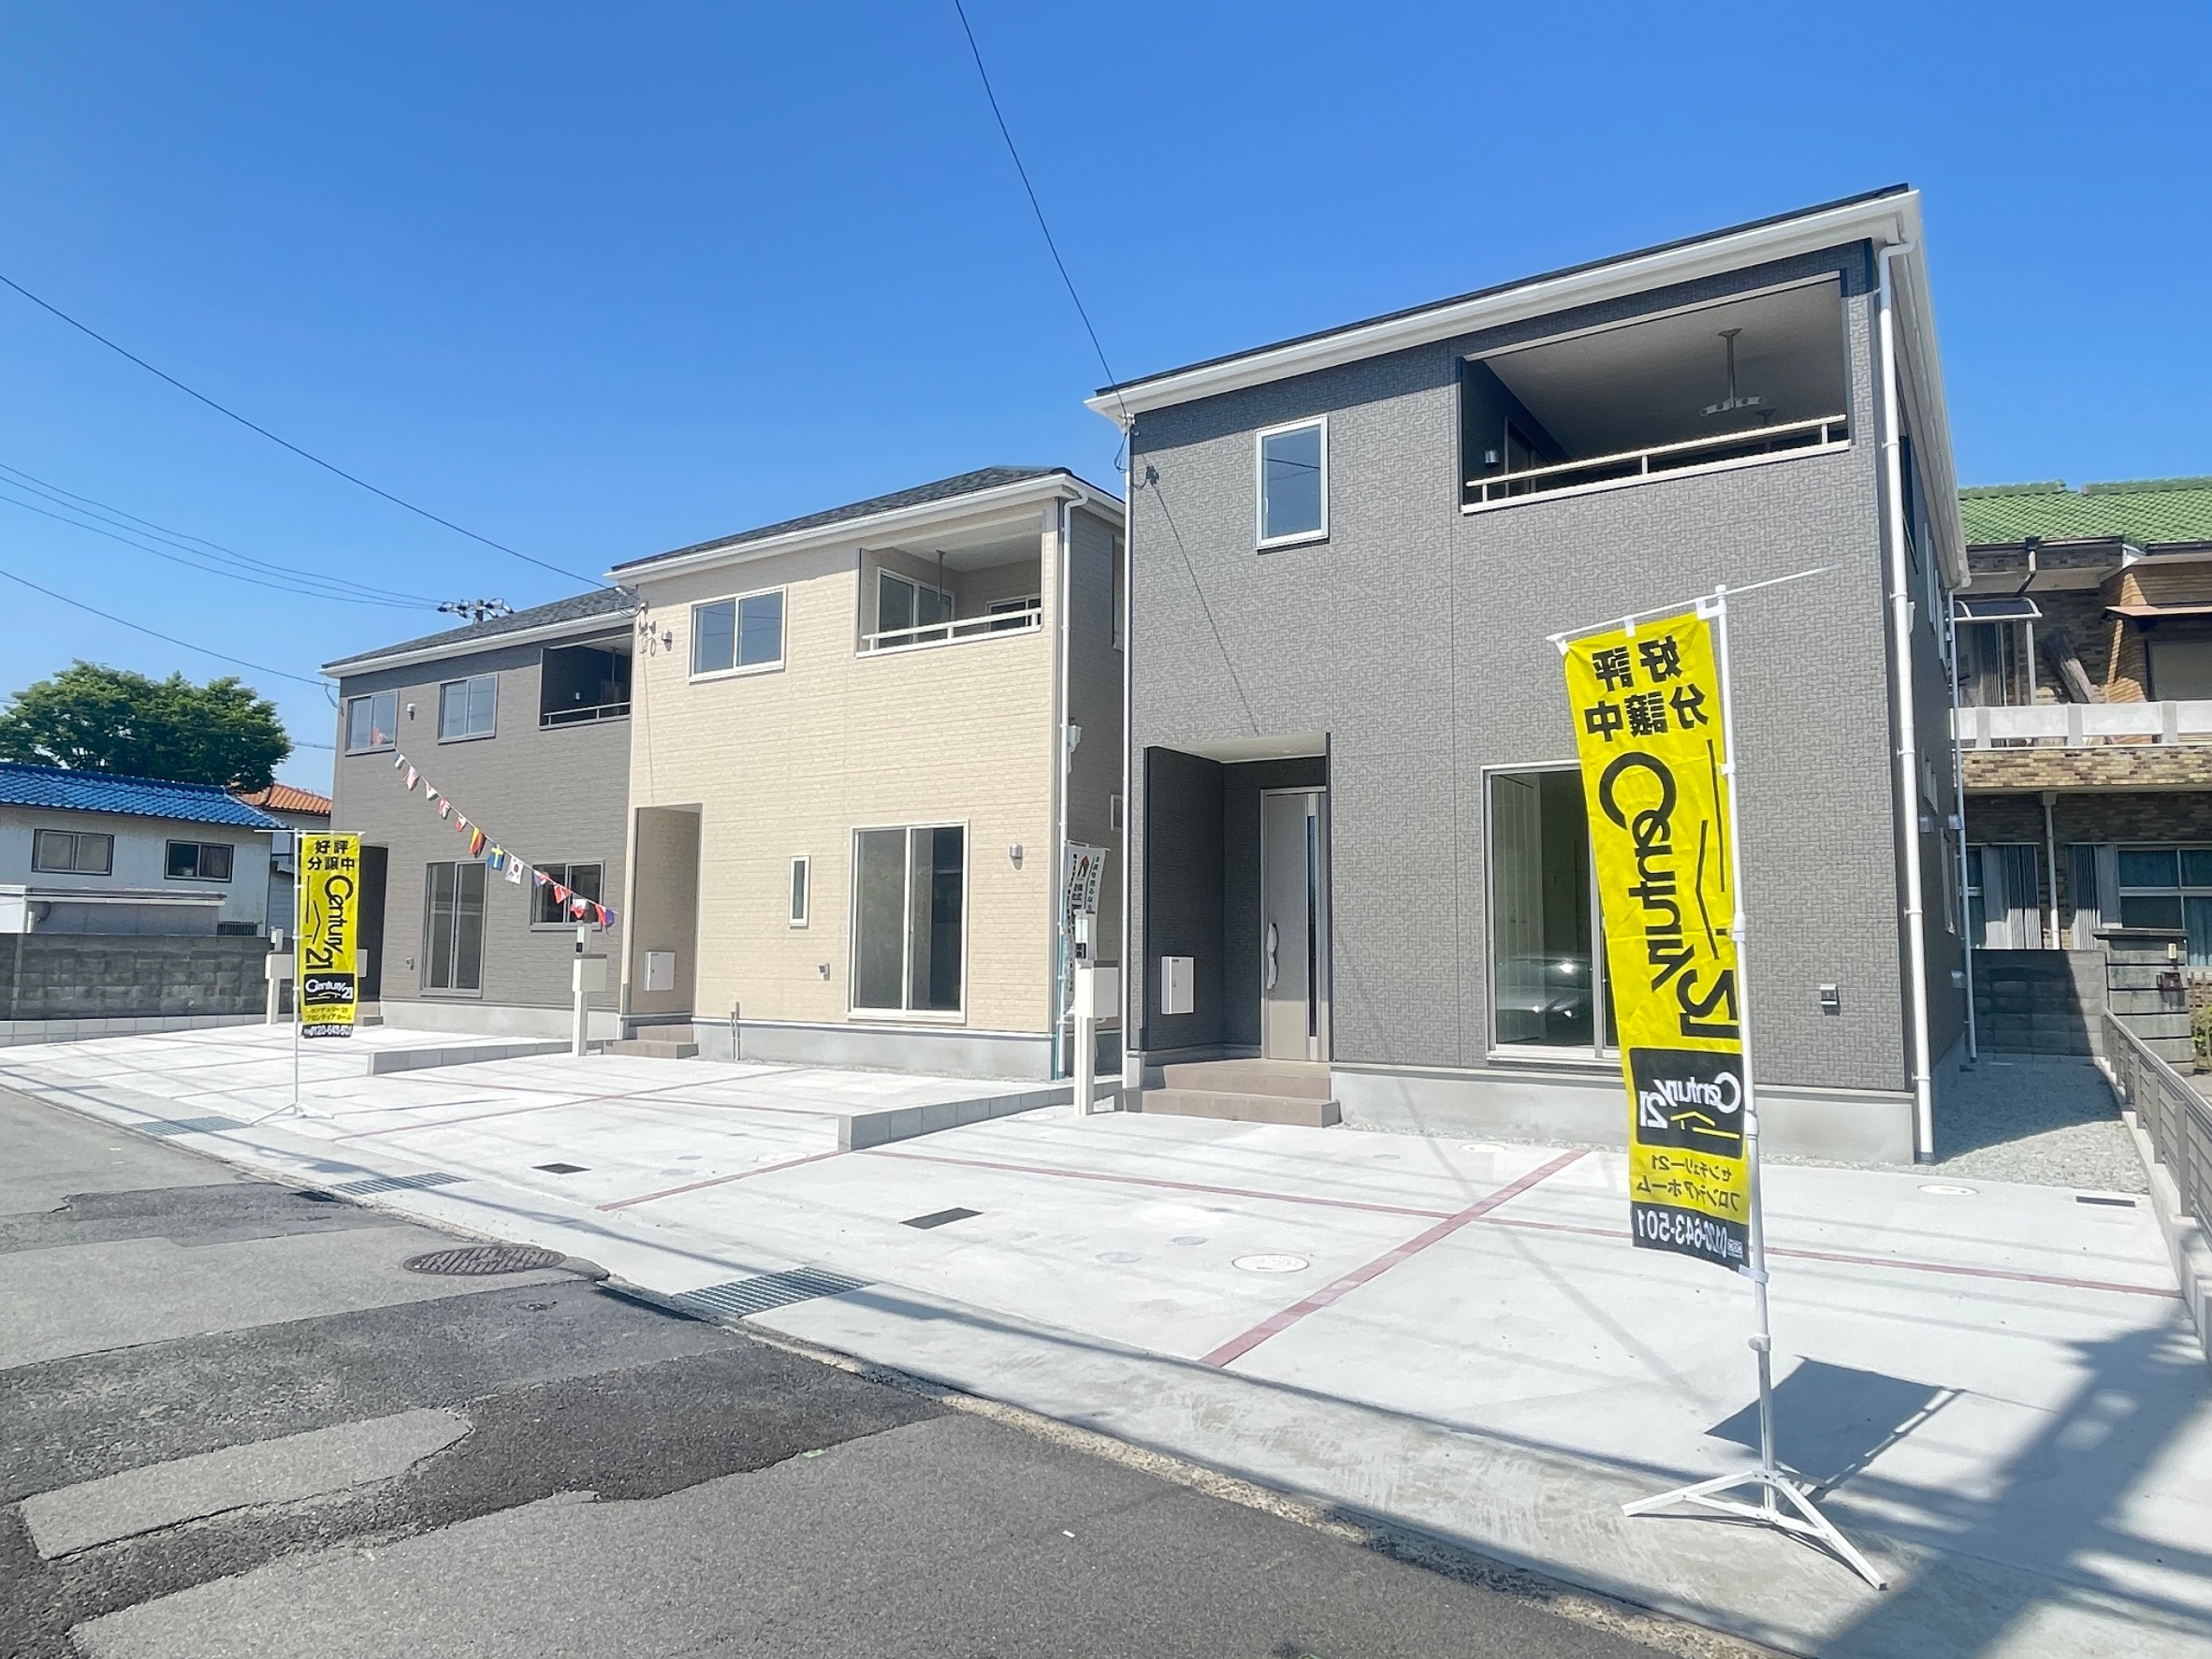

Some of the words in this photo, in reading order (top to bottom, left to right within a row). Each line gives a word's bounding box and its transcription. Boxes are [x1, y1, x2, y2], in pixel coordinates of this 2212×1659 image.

[324, 874, 355, 954] Century
[305, 947, 334, 970] 21
[305, 979, 346, 993] Century
